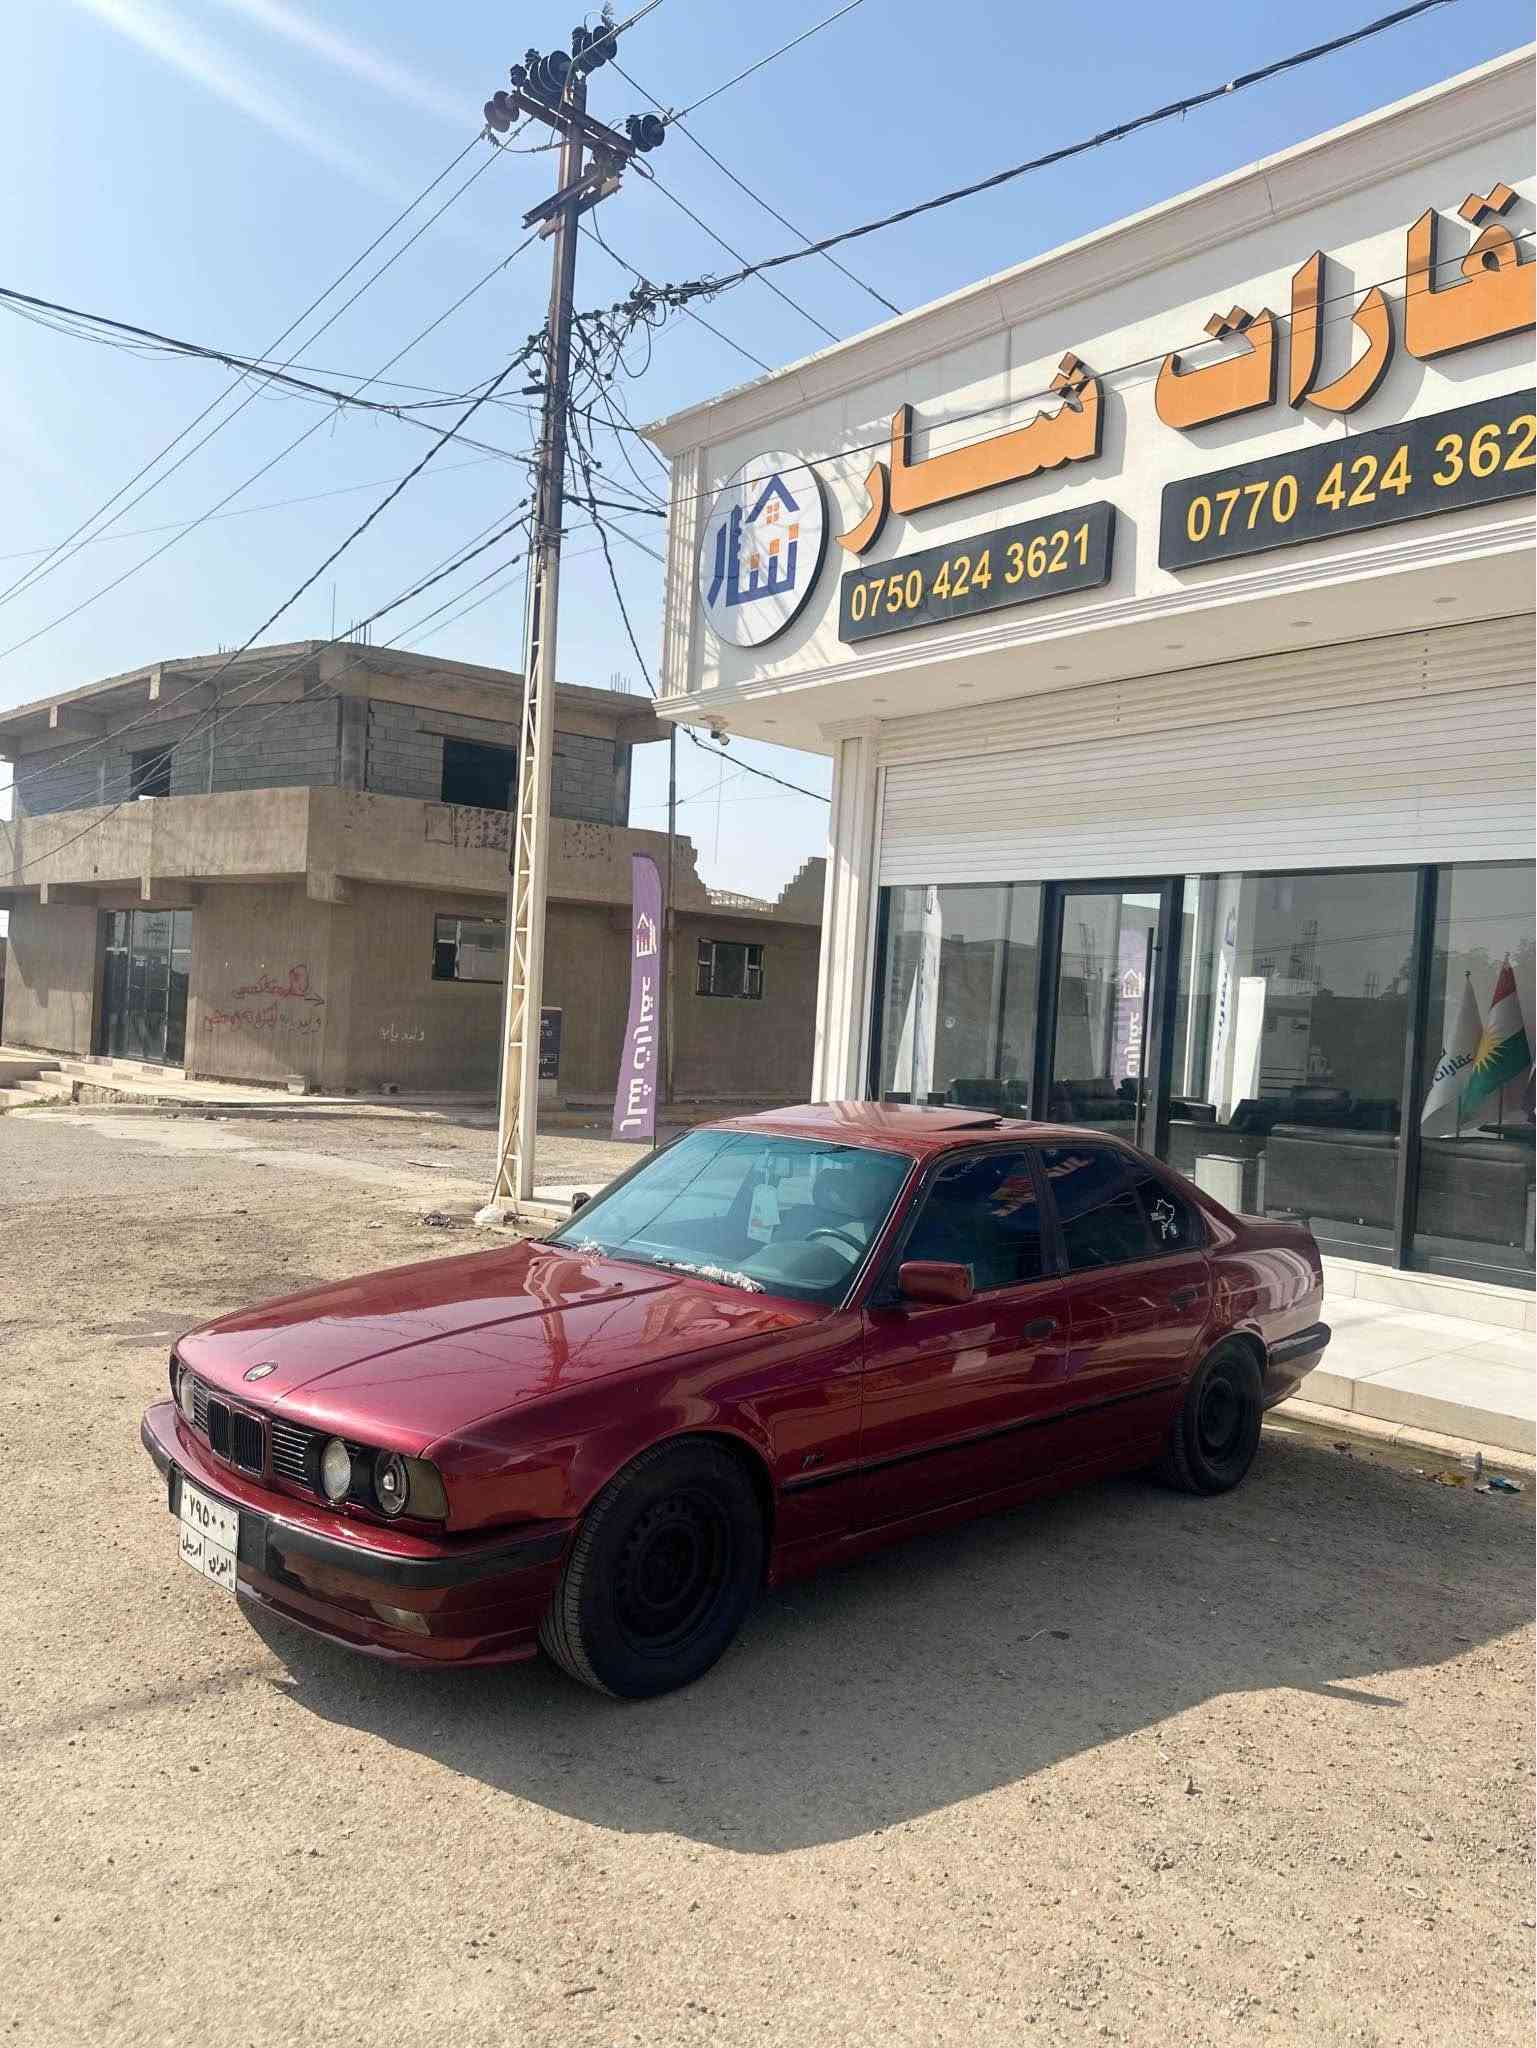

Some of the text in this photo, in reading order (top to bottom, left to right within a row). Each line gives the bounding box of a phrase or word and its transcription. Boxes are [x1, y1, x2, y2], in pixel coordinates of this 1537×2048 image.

[835, 183, 1535, 555] قارات شار
[1187, 474, 1298, 542] 0770
[1316, 445, 1412, 511] 424
[851, 523, 1090, 622] 0750 424 3621
